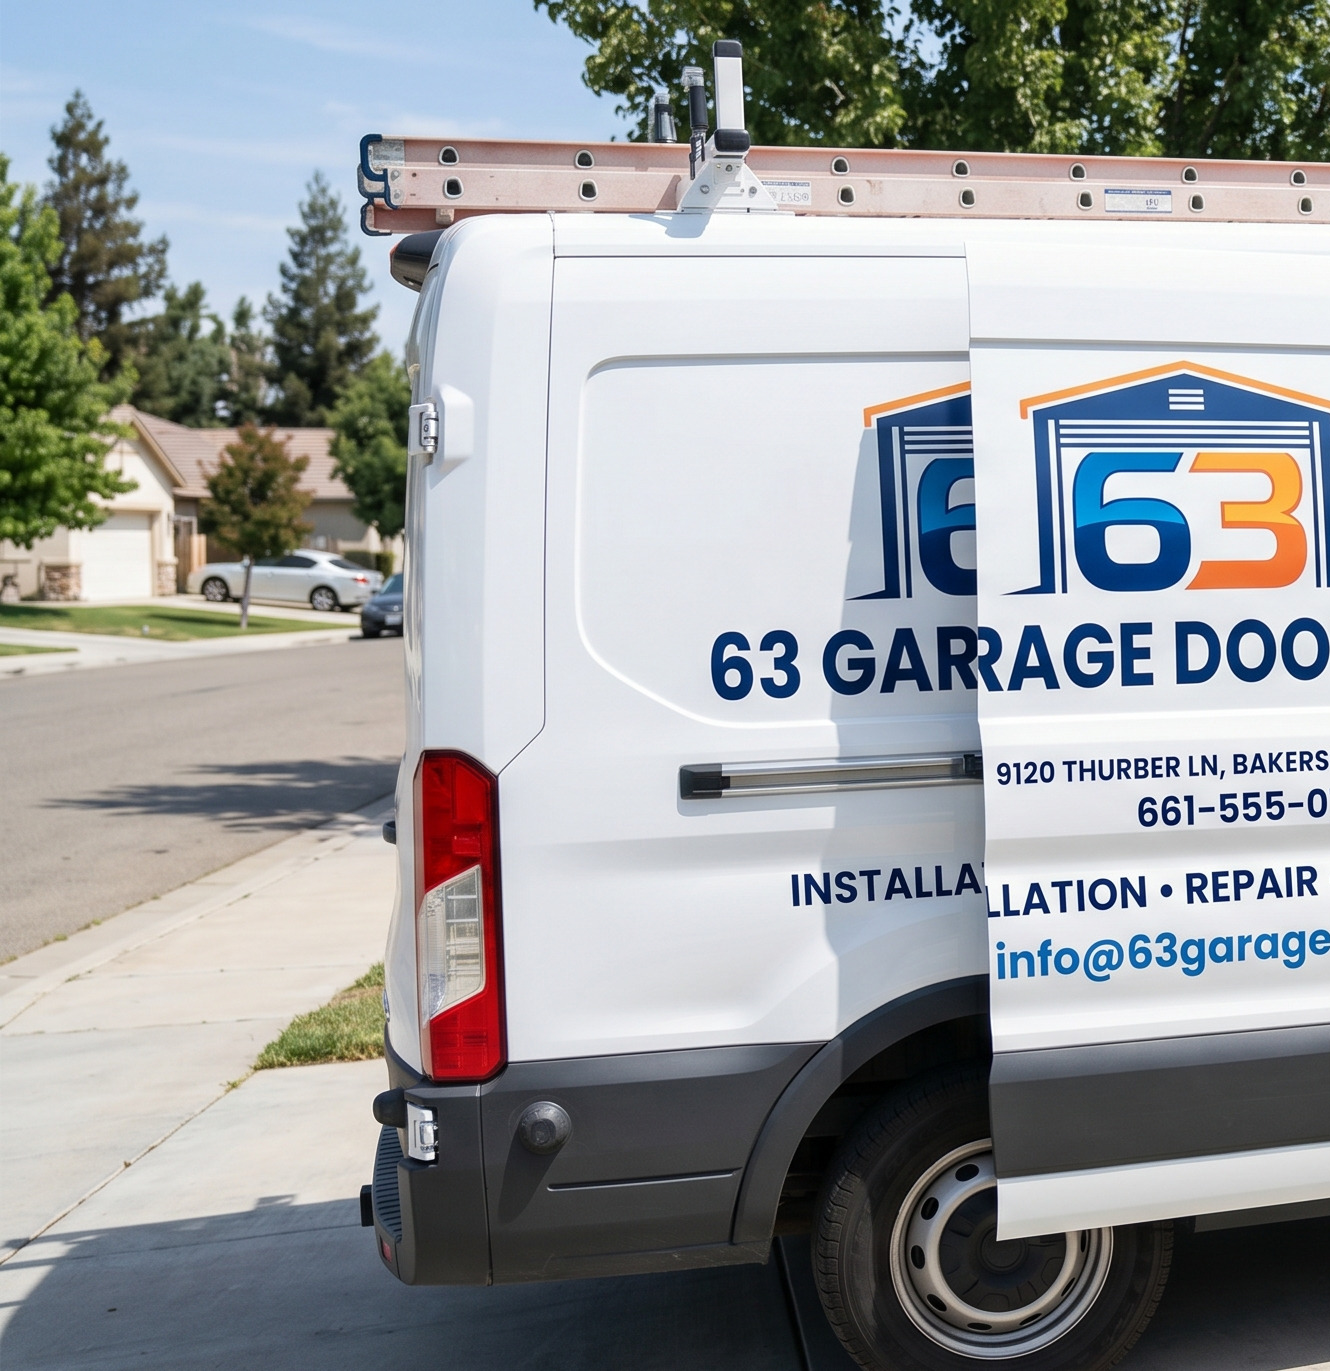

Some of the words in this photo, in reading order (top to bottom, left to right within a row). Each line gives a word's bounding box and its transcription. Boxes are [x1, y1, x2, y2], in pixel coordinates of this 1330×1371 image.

[1073, 451, 1308, 593] 63
[710, 629, 801, 701] 63
[996, 760, 1055, 786] 9120
[1063, 756, 1181, 783] THURBER
[1188, 755, 1223, 780] LN,
[1185, 865, 1319, 905] REPAIR
